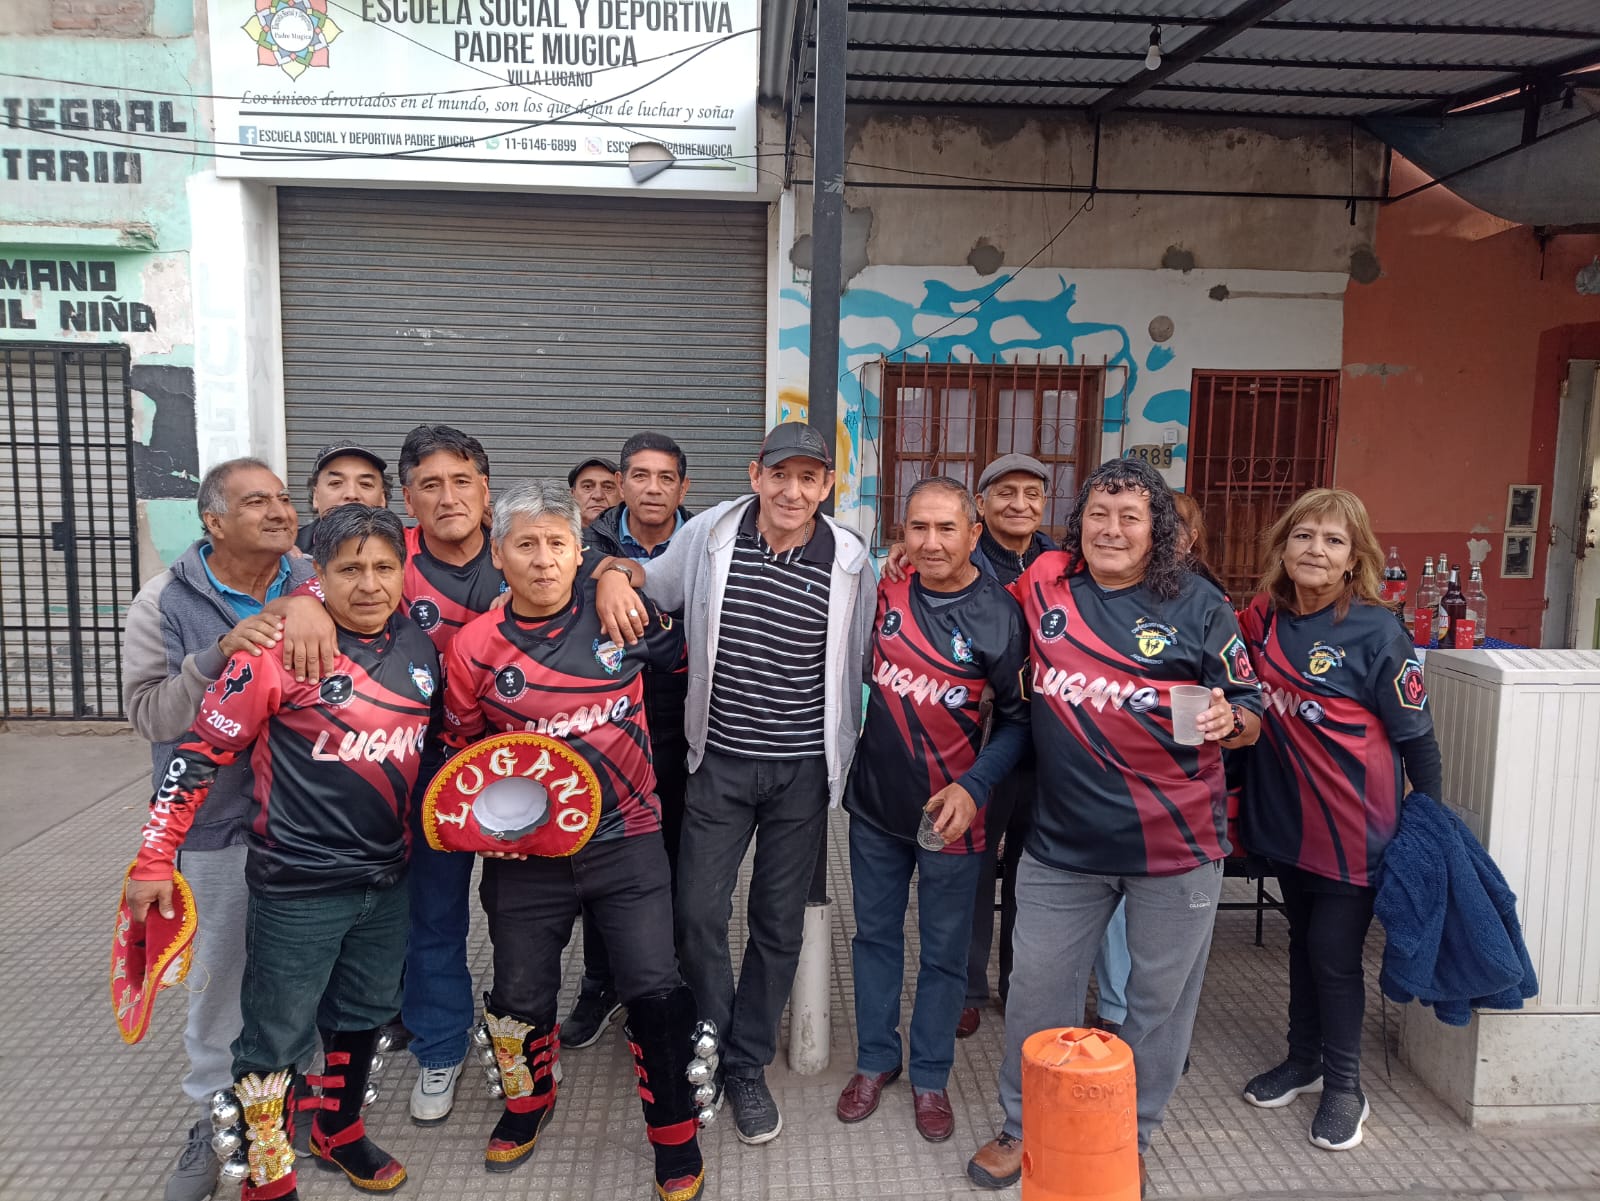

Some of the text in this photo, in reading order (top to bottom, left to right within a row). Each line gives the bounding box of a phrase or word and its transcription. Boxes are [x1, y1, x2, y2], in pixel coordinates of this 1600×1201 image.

[363, 0, 733, 33] ESCUELA SOCIAL Y DEPORTIVA
[455, 30, 638, 67] PADRE MUGICA
[507, 69, 593, 88] VILLA LUGANO
[3, 97, 187, 132] TEGRAL
[241, 90, 268, 105] Los
[272, 91, 318, 106] únicos
[322, 91, 397, 108] derrotados
[400, 97, 417, 109] en
[422, 93, 435, 109] el
[438, 95, 490, 113] mundo,
[495, 101, 519, 113] son
[523, 97, 543, 113] los
[547, 104, 571, 118] que
[576, 98, 613, 119] dejan
[617, 100, 633, 116] de
[638, 100, 683, 118] luchar
[683, 107, 694, 122] y
[259, 129, 476, 149] ESCUELA SOCIAL Y DEPORTIVA PADRE MUGICA
[505, 137, 577, 152] 11-6146-6899
[3, 148, 142, 184] TARIO
[0, 259, 117, 292] MANO
[60, 294, 157, 332] NIÑO
[872, 658, 969, 709] LUGANO
[1031, 662, 1160, 713] LUGANO
[207, 710, 241, 737] 2023
[506, 695, 631, 737] UGANO
[434, 746, 590, 834] LUGANO
